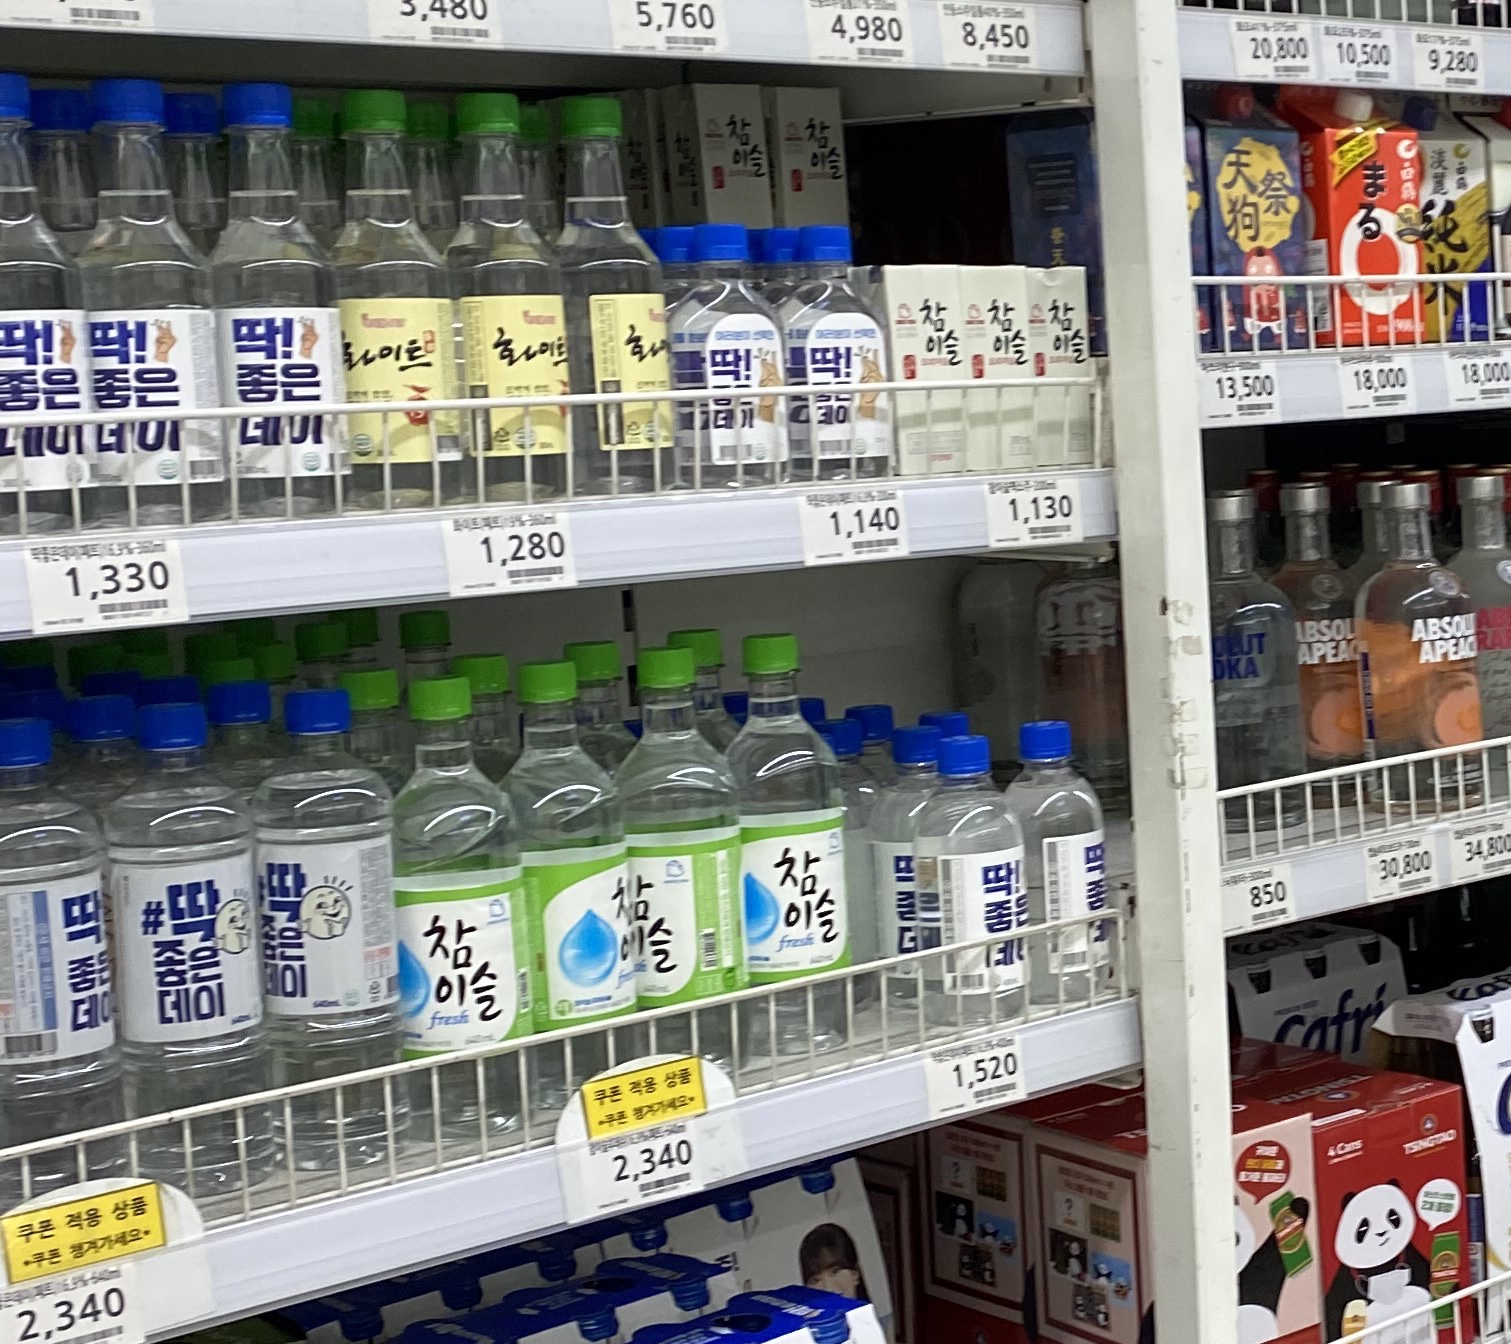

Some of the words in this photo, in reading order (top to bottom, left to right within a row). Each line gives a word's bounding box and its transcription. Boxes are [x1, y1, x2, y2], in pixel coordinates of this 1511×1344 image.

[637, 1, 715, 33] 5,760
[831, 14, 902, 44] 4,980
[962, 21, 1030, 52] 8,450
[1249, 36, 1310, 61] 20,800
[1336, 42, 1391, 68] 10,500
[1428, 48, 1478, 74] 9,280
[727, 114, 751, 142] 참
[806, 117, 831, 145] 참
[732, 146, 766, 180] 이슬
[810, 146, 842, 181] 이슬
[1358, 163, 1387, 241] まる
[920, 298, 948, 329] 참
[987, 298, 1015, 329] 참
[1050, 298, 1077, 329] 참
[90, 319, 147, 364] 딱!
[233, 317, 296, 360] 딱!
[926, 330, 963, 367] 이슬
[993, 331, 1029, 367] 이슬
[1053, 331, 1086, 365] 이슬
[710, 348, 752, 381] 딱!
[809, 346, 853, 378] 딱!
[1462, 362, 1511, 385] 18,000
[94, 367, 180, 408] 좋은
[236, 364, 322, 404] 좋은
[1216, 375, 1274, 401] 13,500
[1354, 367, 1408, 391] 18,000
[829, 506, 899, 539] 1,140
[1008, 494, 1073, 525] 1,130
[479, 530, 566, 567] 1,280
[64, 561, 169, 600] 1,330
[1418, 636, 1478, 665] APEAC
[774, 847, 821, 896] 참
[1380, 851, 1432, 880] 30,800
[1250, 881, 1287, 907] 850
[784, 888, 838, 943] 이슬
[424, 915, 477, 970] 참
[777, 932, 815, 952] fresh
[158, 981, 226, 1025] 데이
[435, 961, 503, 1022] 이슬
[430, 1008, 469, 1029] fresh
[594, 1085, 623, 1106] 쿠폰
[629, 1076, 658, 1096] 적용
[664, 1067, 692, 1088] 상품
[952, 1054, 1018, 1089] 1,520
[613, 1139, 692, 1182] 2,340
[16, 1218, 56, 1244] 쿠폰
[66, 1207, 102, 1231] 적용
[111, 1196, 149, 1221] 상품
[16, 1287, 125, 1343] 2,340
